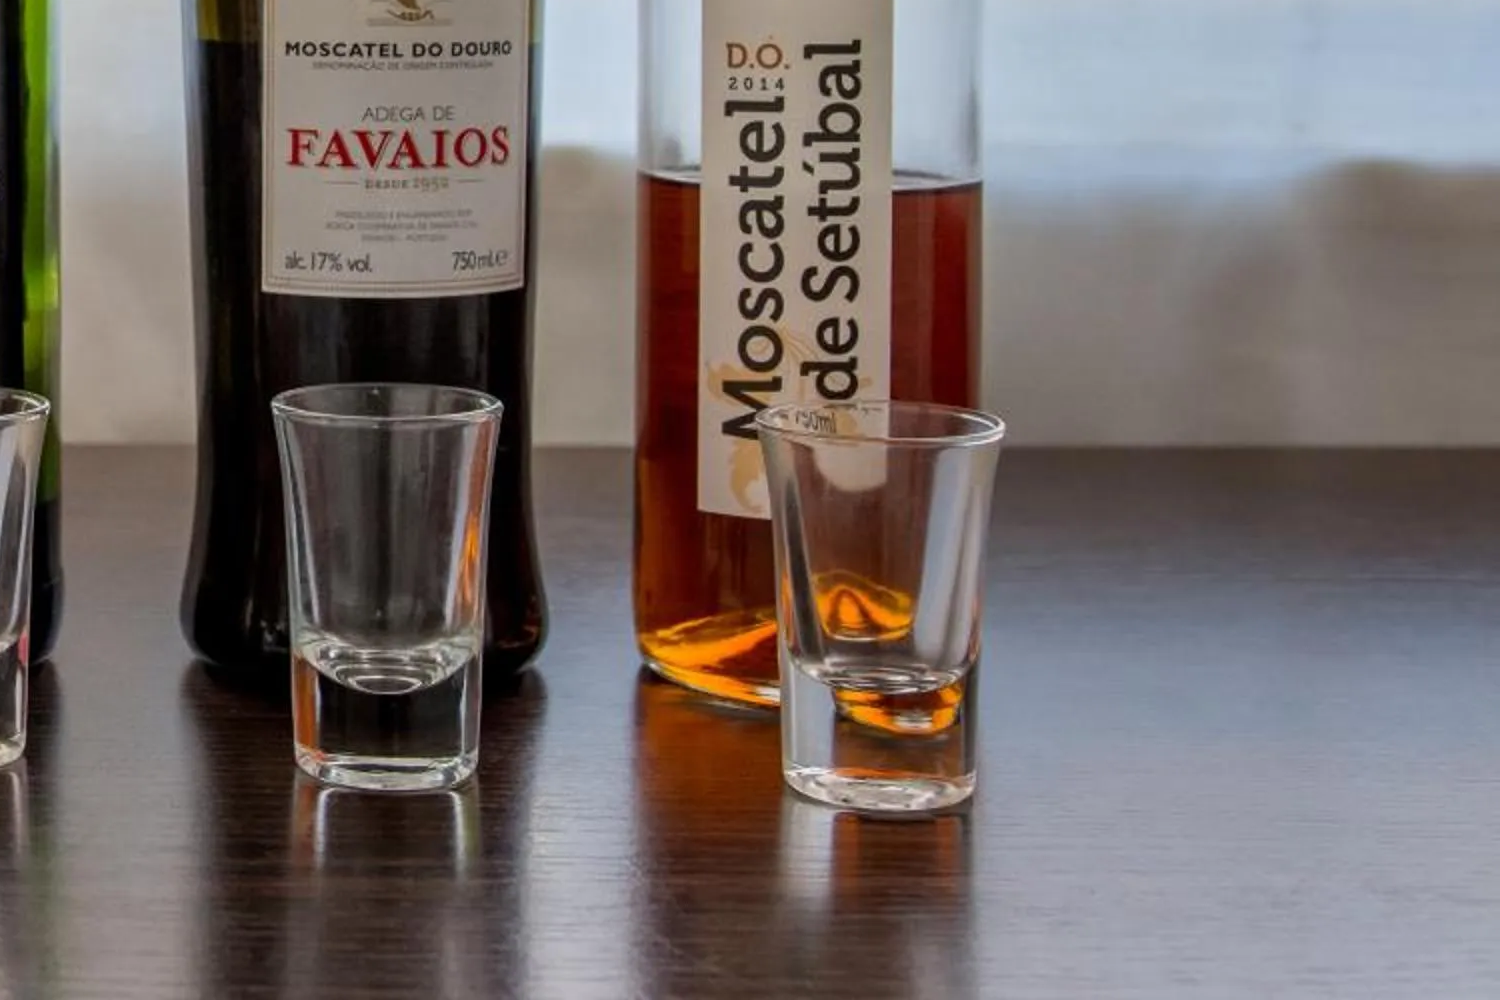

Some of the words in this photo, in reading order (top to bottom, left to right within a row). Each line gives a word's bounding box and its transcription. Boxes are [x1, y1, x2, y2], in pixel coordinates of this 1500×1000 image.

[285, 41, 404, 57] MOSCATEL
[412, 43, 443, 57] DO
[450, 40, 512, 57] DOURO
[728, 76, 785, 91] 2014
[361, 106, 426, 122] ADEGA
[432, 105, 457, 121] DE
[286, 126, 510, 170] FAVAIOS
[801, 38, 862, 303] Setúbal
[310, 252, 343, 271] 17%
[348, 253, 373, 273] vol.
[721, 96, 786, 440] Moscatel
[800, 316, 859, 401] de
